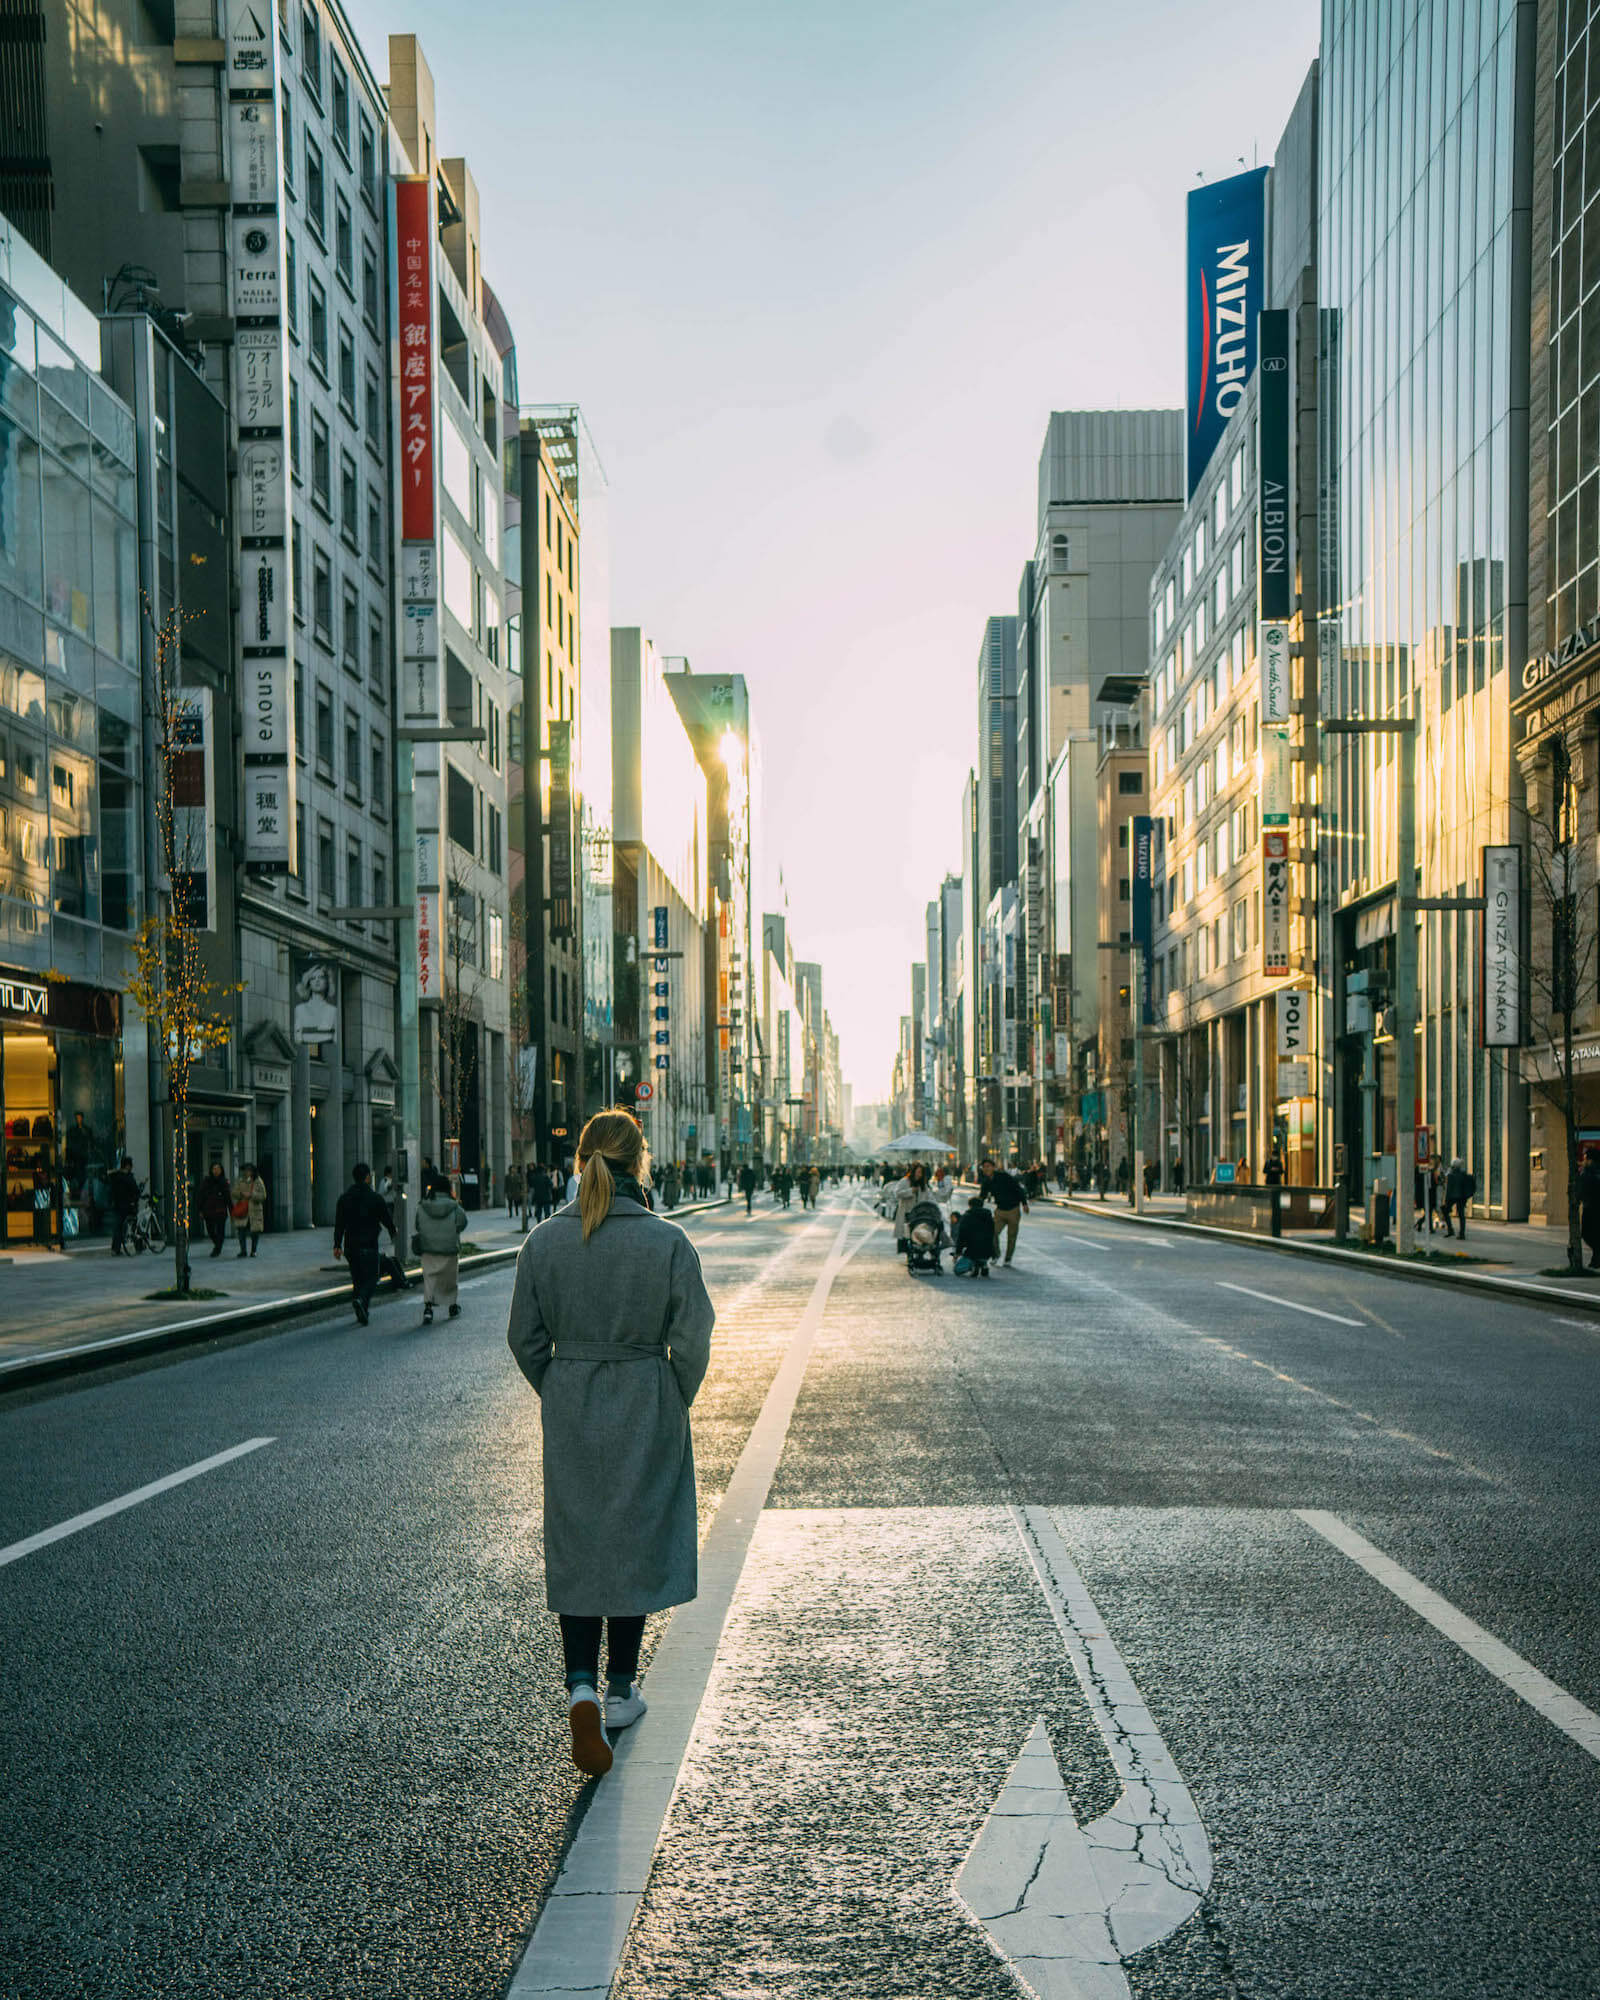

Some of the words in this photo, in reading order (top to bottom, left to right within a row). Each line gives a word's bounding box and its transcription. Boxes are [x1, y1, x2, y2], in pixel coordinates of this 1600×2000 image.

[237, 268, 277, 281] Terra
[406, 237, 423, 308] 中国名菜
[240, 334, 278, 345] GINZA
[1215, 239, 1250, 418] MIZUHO
[247, 351, 260, 422] クリニック
[261, 351, 273, 409] オーラル
[404, 322, 428, 488] 銀座アスター
[1264, 480, 1285, 574] ALBION
[1522, 626, 1588, 690] GINZA
[1496, 891, 1509, 955] GINZA
[656, 962, 671, 1070] MELSA
[1286, 995, 1300, 1049] POLA
[1495, 958, 1508, 1033] TANAKA
